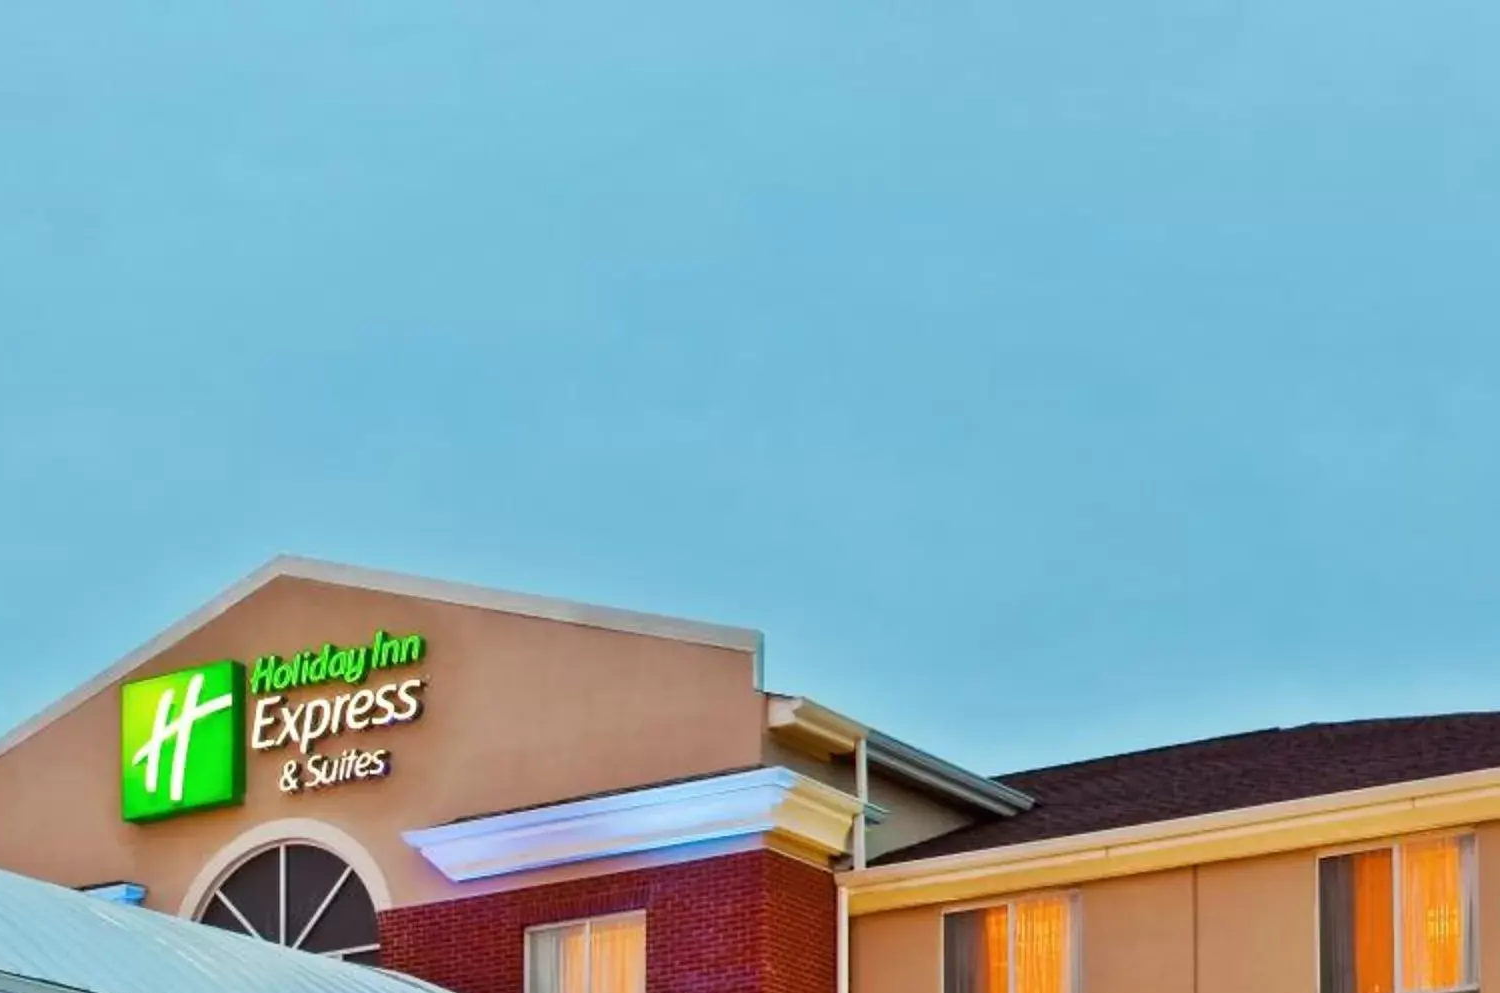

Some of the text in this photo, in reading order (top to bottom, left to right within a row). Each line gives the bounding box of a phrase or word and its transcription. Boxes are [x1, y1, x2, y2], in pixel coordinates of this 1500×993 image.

[251, 630, 422, 695] Holiday Inn
[132, 673, 233, 801] H
[252, 679, 421, 753] Express
[279, 749, 386, 792] & Suites
